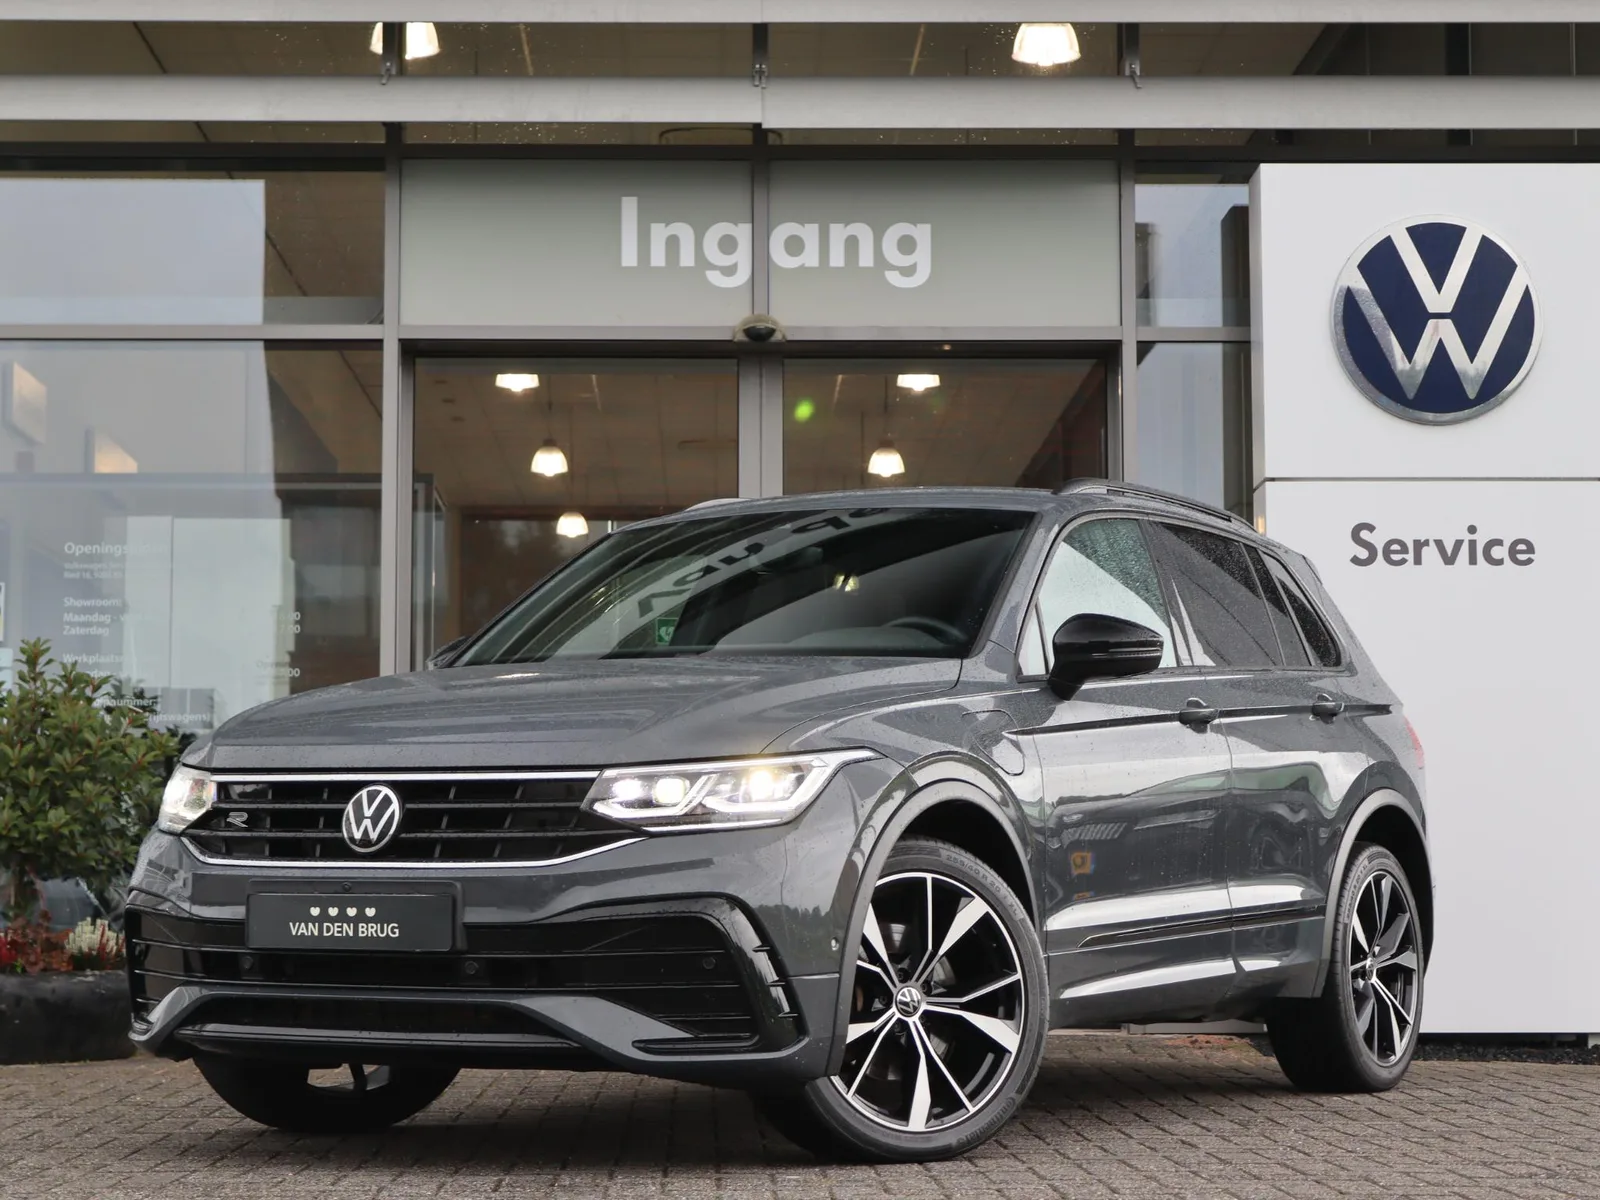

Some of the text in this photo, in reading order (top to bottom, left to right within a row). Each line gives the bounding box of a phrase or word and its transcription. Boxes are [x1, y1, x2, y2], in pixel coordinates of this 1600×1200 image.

[620, 196, 932, 288] Ingang
[1350, 522, 1535, 566] Service
[63, 612, 111, 624] Maandag
[63, 625, 109, 637] Zaterdag
[289, 922, 400, 938] VAN DEN BRUG
